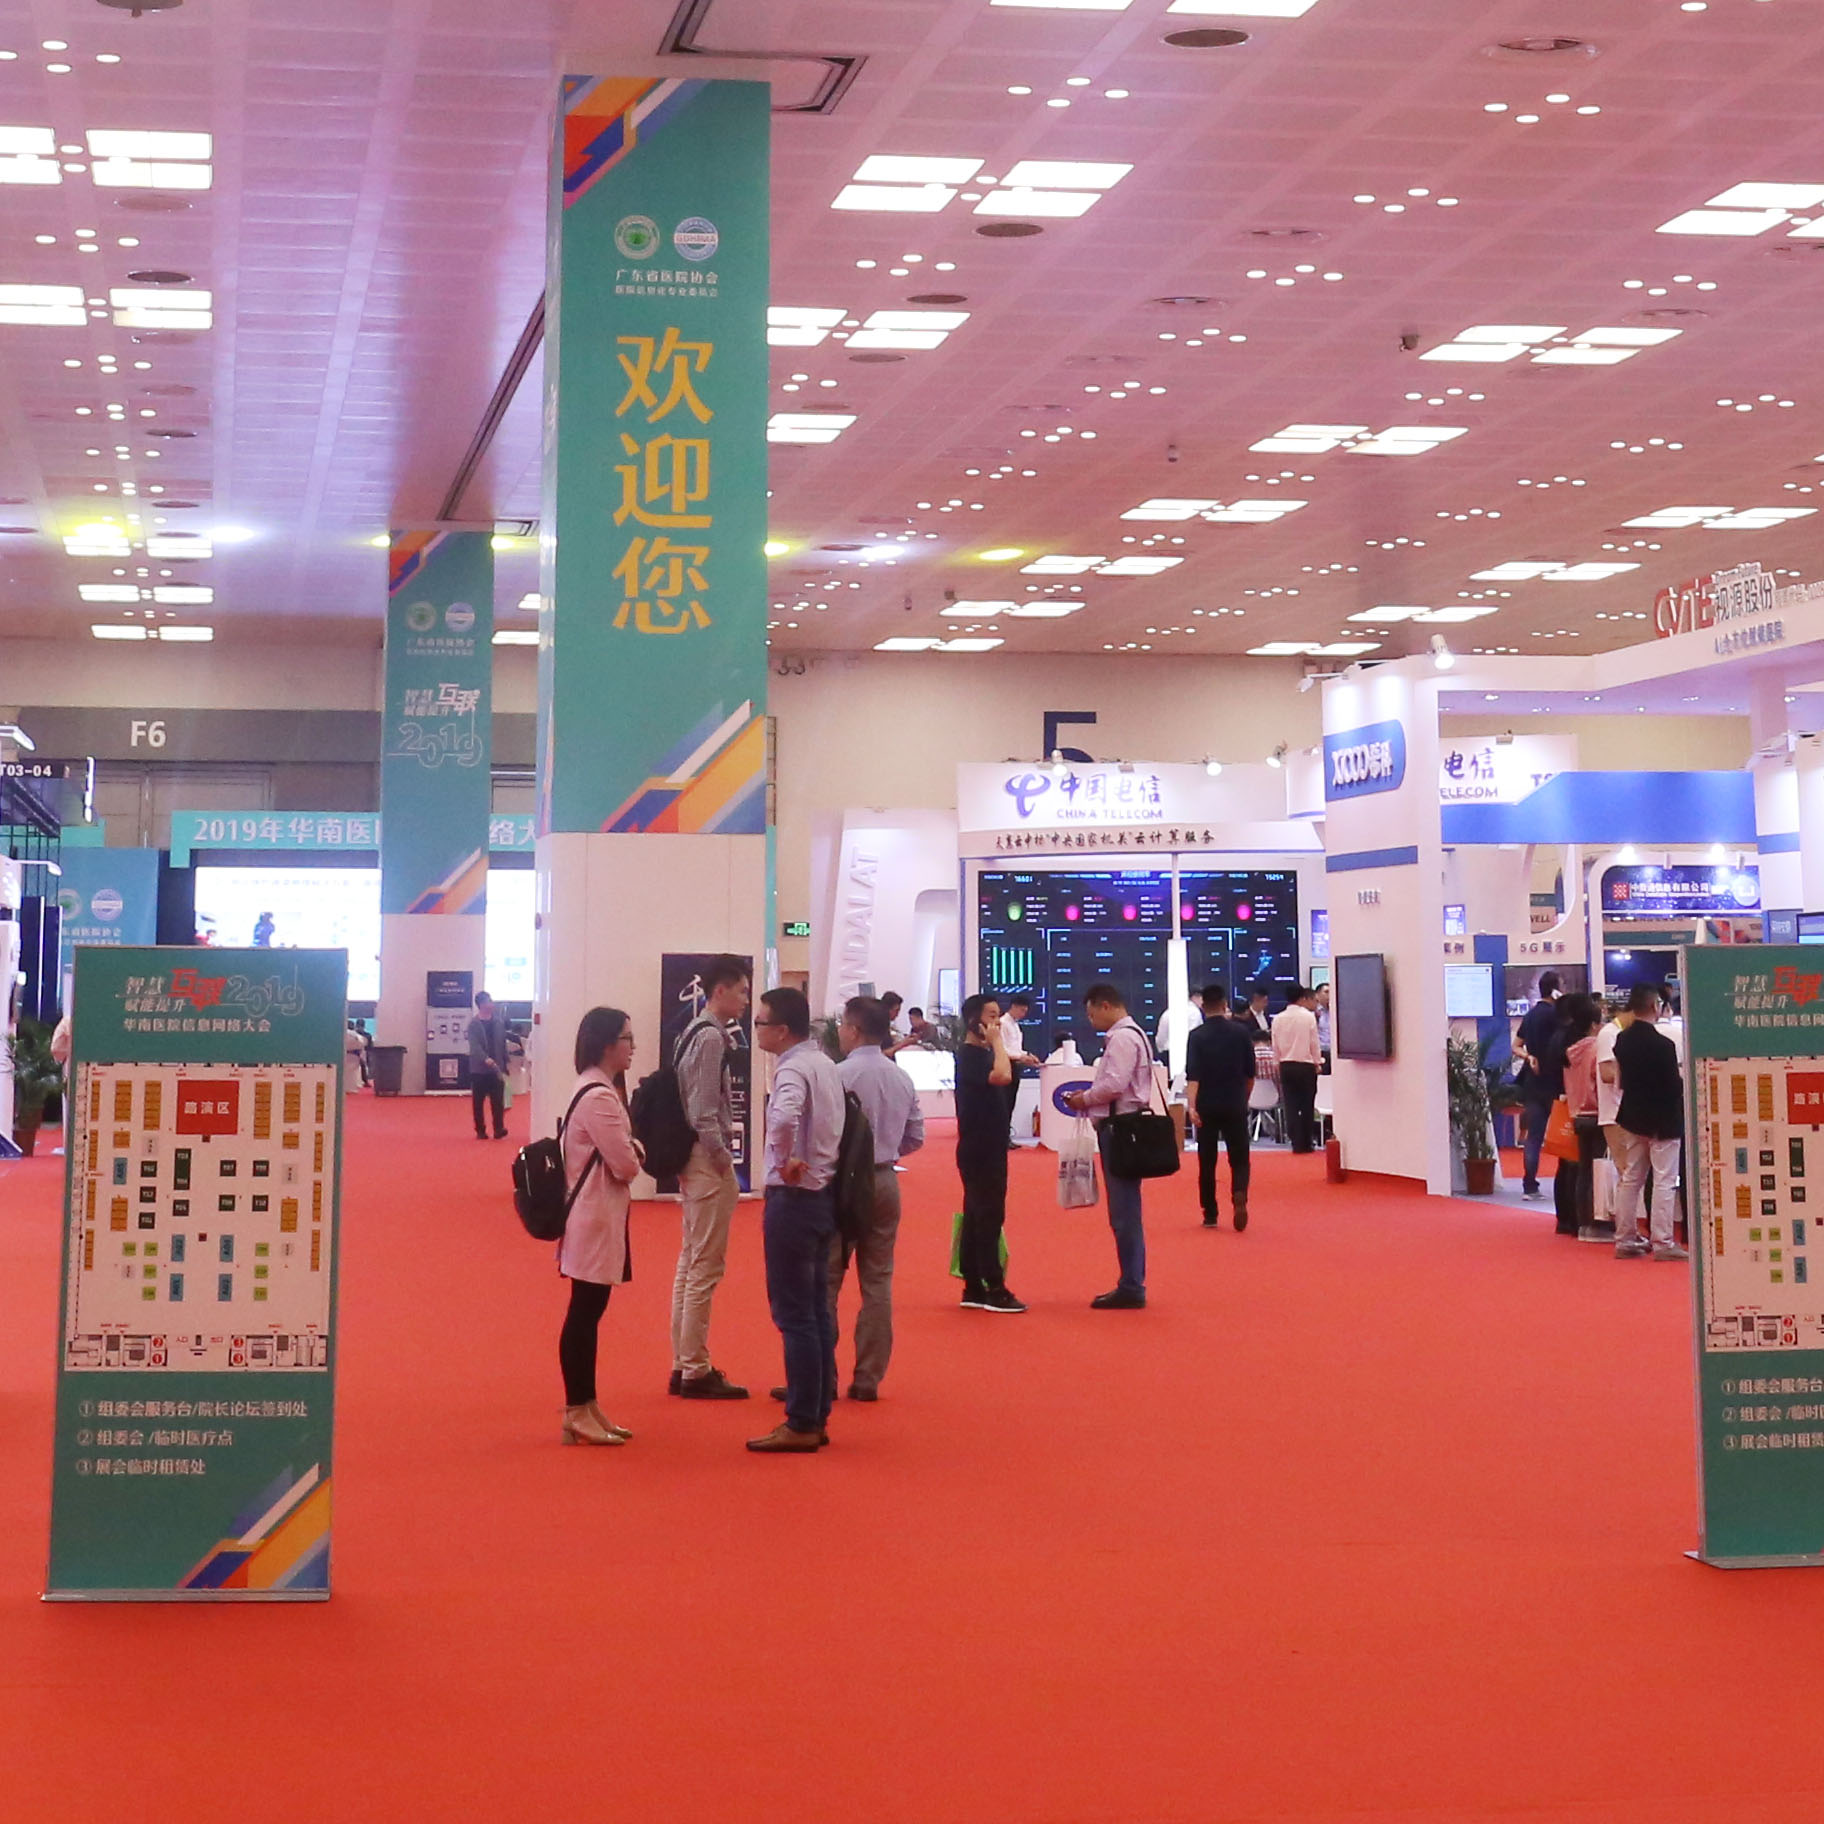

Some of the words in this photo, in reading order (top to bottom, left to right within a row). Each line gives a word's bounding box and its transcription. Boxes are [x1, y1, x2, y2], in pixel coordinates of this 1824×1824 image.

[612, 326, 714, 636] 欢迎您
[1713, 573, 1774, 624] 视源股份
[436, 683, 480, 716] 互联
[131, 720, 166, 748] F6
[398, 721, 483, 768] 2019
[1444, 747, 1496, 780] 电信
[1059, 773, 1162, 805] 中国电信
[1056, 809, 1098, 820] CHINA
[1103, 808, 1164, 820] TELECOM
[194, 816, 381, 845] 2019年华南医
[125, 976, 164, 996] 智慧
[168, 968, 228, 1011] 互联
[227, 964, 305, 1018] 2019
[1771, 966, 1823, 1007] 互联
[124, 997, 186, 1013] 赋能提升
[123, 1018, 272, 1034] 华南医院信息网络大会
[184, 1101, 230, 1115] 路演区
[97, 1400, 308, 1418] 组委会服务台/院长论坛签到处
[1740, 1406, 1783, 1422] 组委会
[96, 1430, 144, 1446] 组委会
[95, 1458, 206, 1476] 展会临时租赁处
